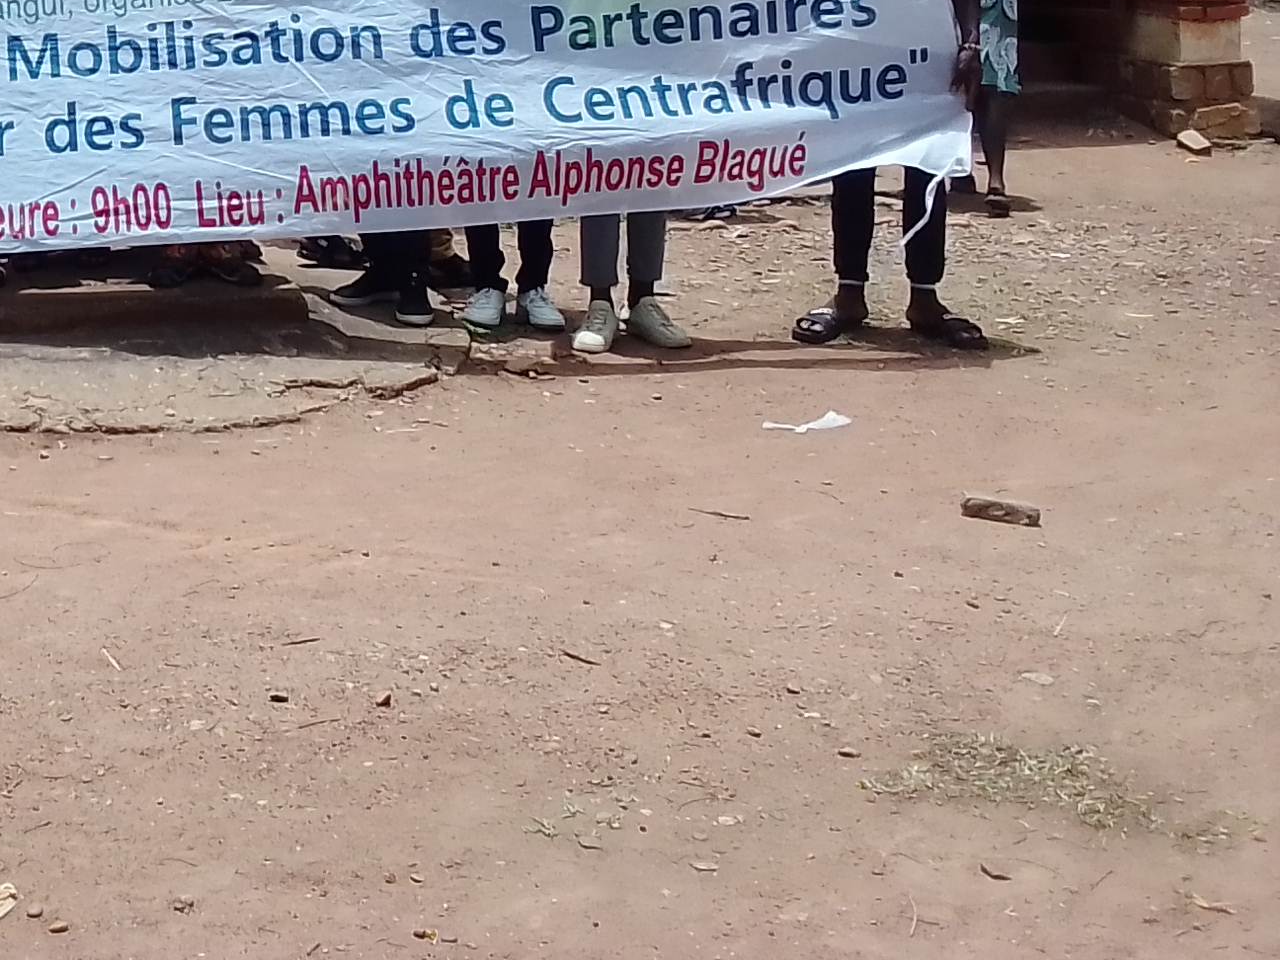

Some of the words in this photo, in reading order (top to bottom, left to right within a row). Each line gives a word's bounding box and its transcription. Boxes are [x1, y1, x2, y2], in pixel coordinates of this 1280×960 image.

[6, 12, 385, 83] Mobilisation
[408, 8, 507, 58] des
[44, 101, 144, 154] des
[170, 95, 415, 146] Femmes
[444, 80, 516, 130] de
[91, 182, 171, 234] 9h00
[195, 180, 265, 228] Lieu
[293, 153, 519, 223] Amphithéâtre
[527, 146, 684, 206] Alphonse
[692, 132, 807, 191] Blagué
